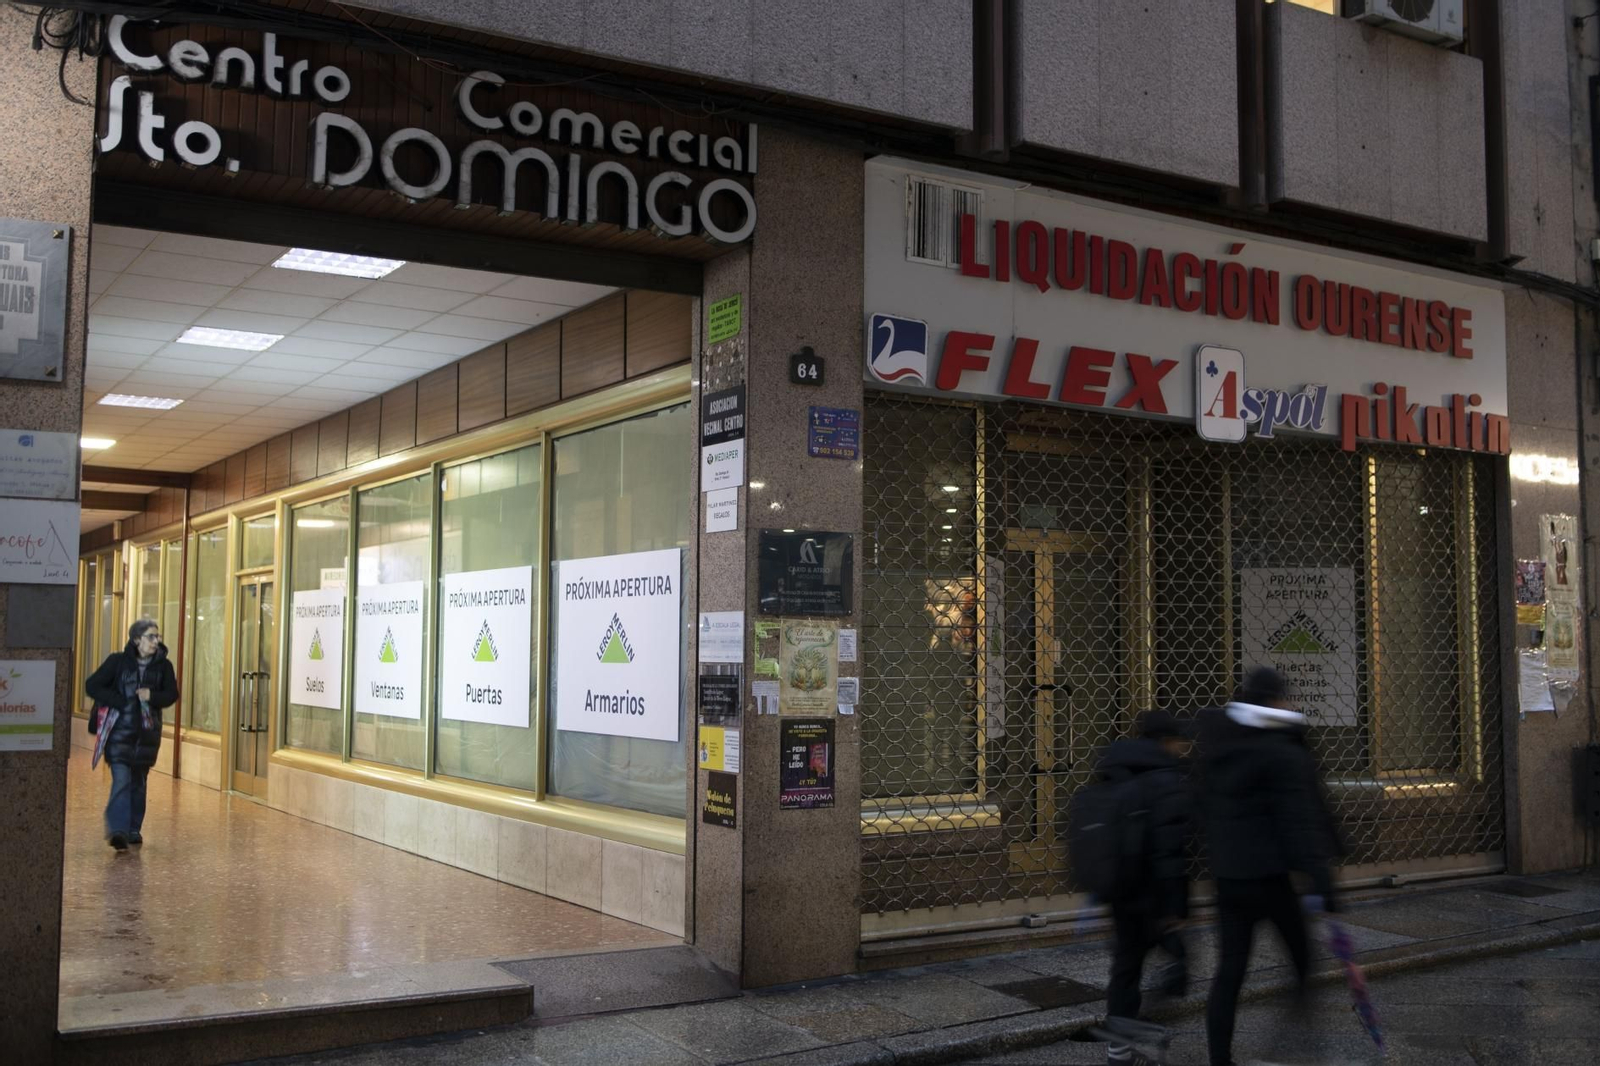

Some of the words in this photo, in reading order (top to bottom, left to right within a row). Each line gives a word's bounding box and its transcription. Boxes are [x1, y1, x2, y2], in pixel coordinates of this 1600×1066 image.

[108, 14, 351, 102] Centro
[101, 75, 240, 172] Sto.
[458, 70, 758, 173] Comercial
[312, 112, 758, 243] DOMINGO
[960, 213, 1280, 325] LIQUIDACIÓN
[1294, 274, 1473, 360] OURENSE
[797, 363, 818, 379] 64
[934, 330, 1180, 414] FLEX
[1203, 370, 1329, 438] Aspol
[1340, 382, 1512, 455] pikolin
[703, 420, 723, 437] VECINAL
[724, 414, 744, 432] CENTRO
[449, 588, 482, 608] PRÓXIMA
[483, 588, 526, 606] APERTURA
[565, 576, 612, 600] PRÓXIMA
[612, 575, 672, 597] APERTURA
[1266, 589, 1329, 600] APERTURA
[316, 604, 341, 618] APERTURA
[361, 598, 387, 616] PRÓXIMA
[388, 600, 419, 615] APERTURA
[471, 627, 485, 660] LEROY
[482, 619, 499, 662] MERLIN
[596, 621, 615, 661] LEROY
[611, 612, 636, 662] MERLIN
[1264, 616, 1297, 651] LEROY
[1292, 609, 1339, 652] MERLIN
[1275, 661, 1322, 672] Puertas
[306, 677, 325, 693] Suelos
[371, 681, 404, 700] Ventanas
[466, 683, 502, 705] Puertas
[584, 689, 645, 716] Armarios
[792, 745, 806, 753] PERO
[781, 794, 833, 802] PANORAMA
